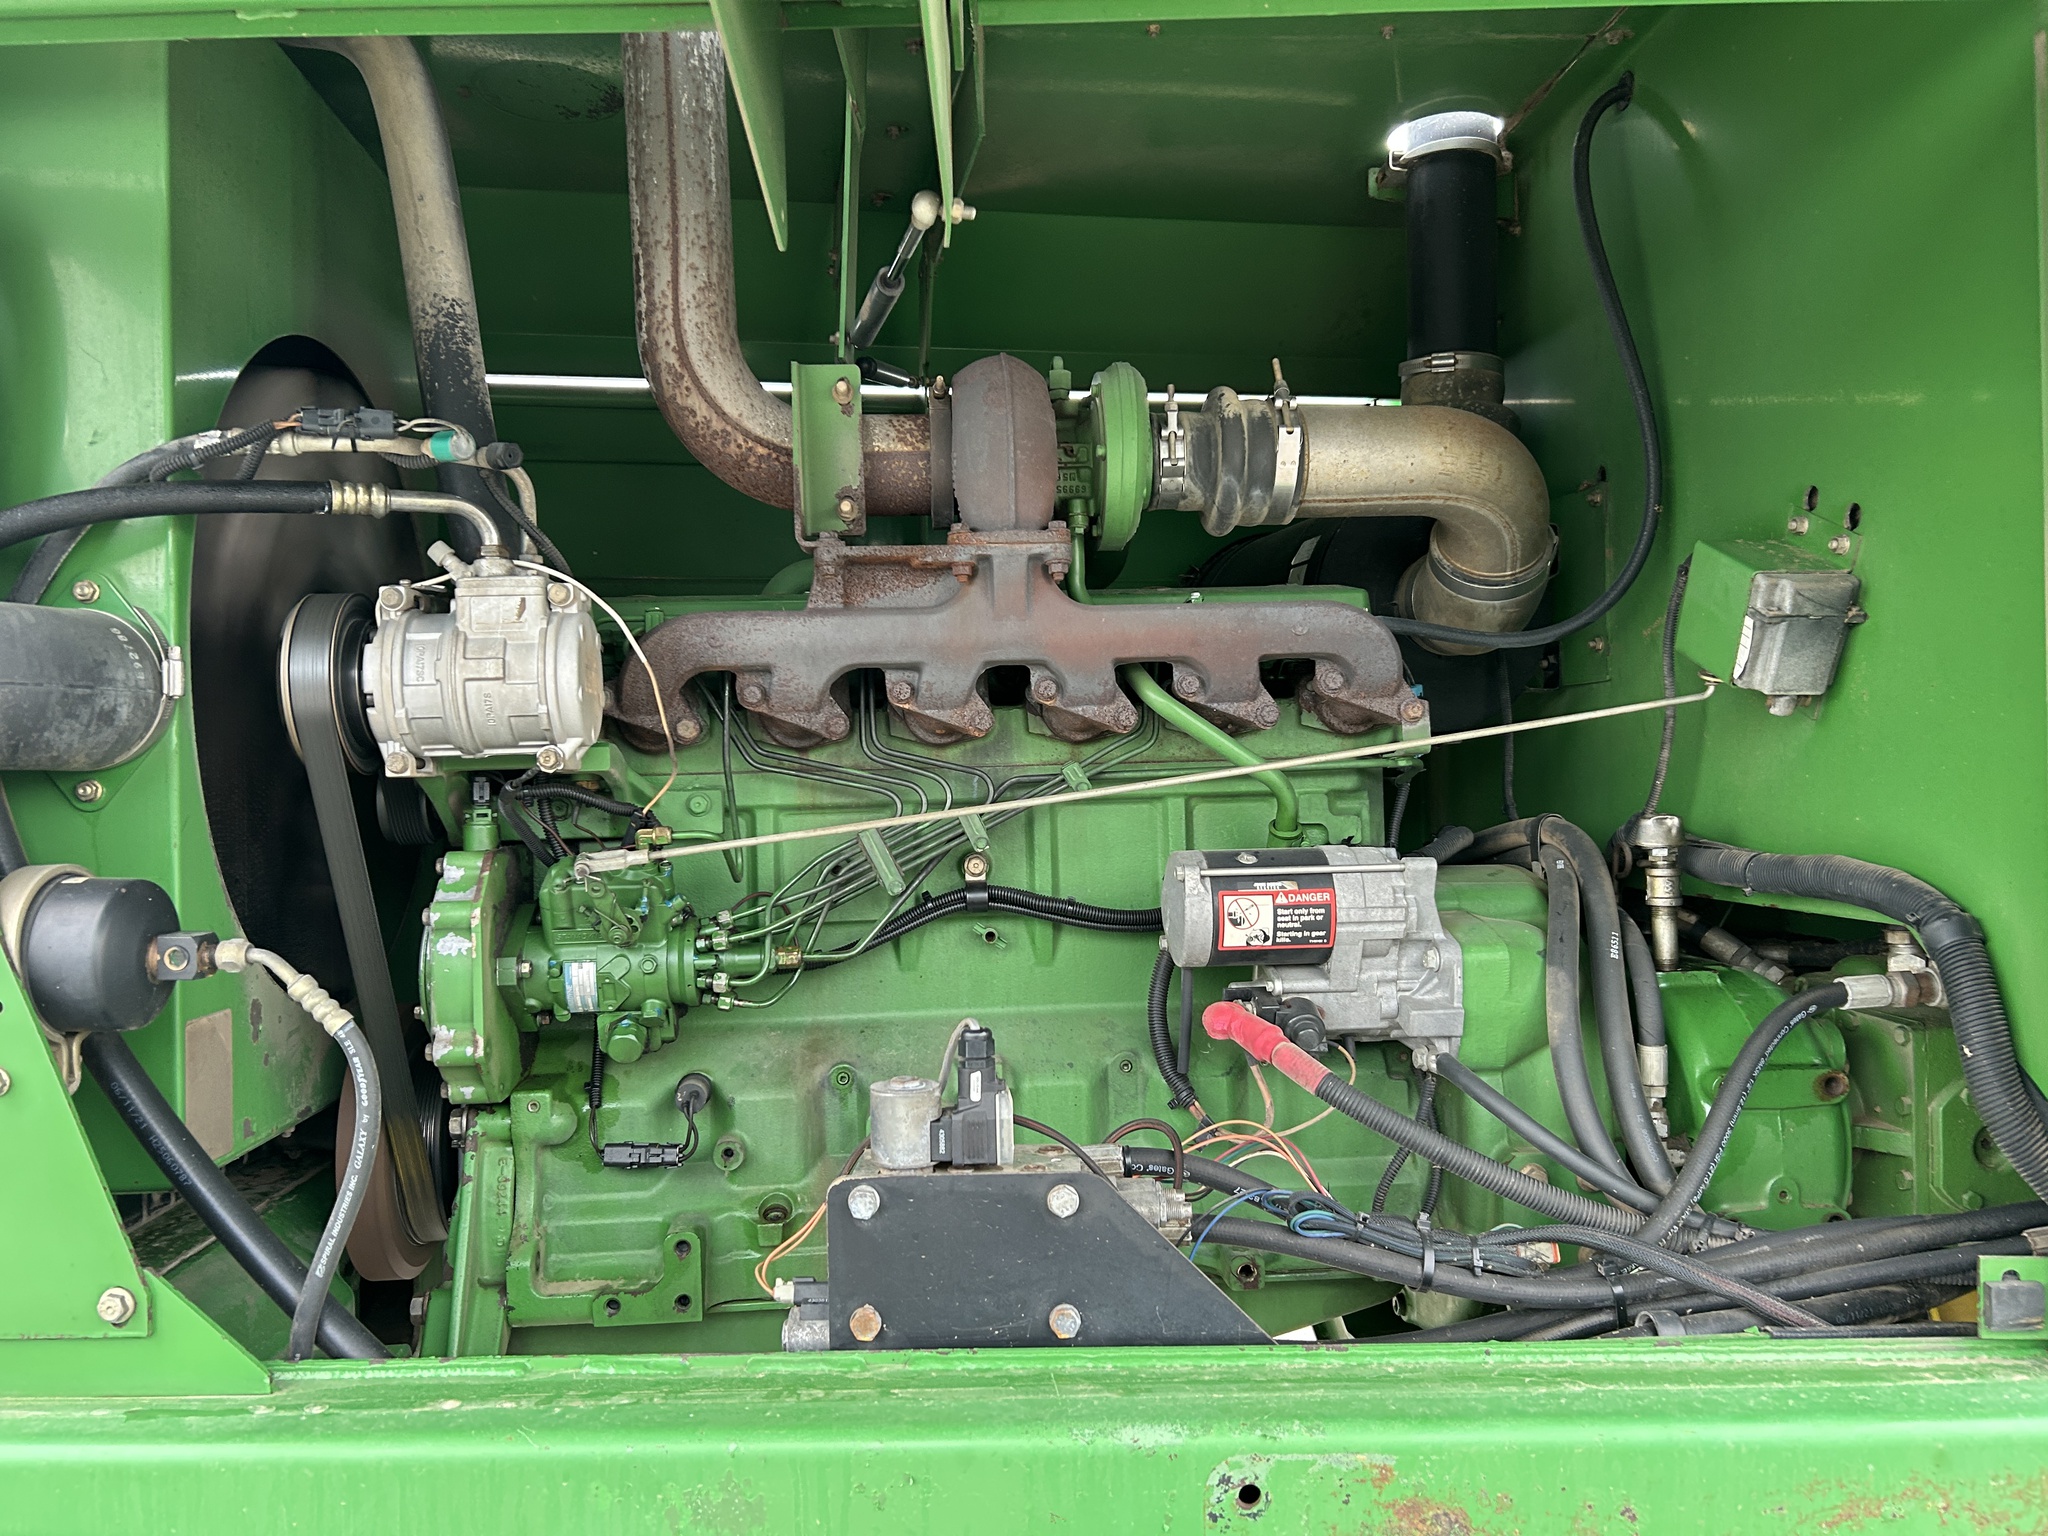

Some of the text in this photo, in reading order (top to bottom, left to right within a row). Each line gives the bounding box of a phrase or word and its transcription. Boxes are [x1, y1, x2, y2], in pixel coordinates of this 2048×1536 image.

[1287, 892, 1331, 903] DANGER
[1294, 908, 1309, 916] only
[1276, 930, 1303, 938] Starting
[1610, 931, 1619, 959] E86511
[352, 1056, 369, 1107] GOODYEAR
[361, 1114, 370, 1123] by
[353, 1128, 368, 1170] GALAXY
[348, 1174, 359, 1192] INC.
[331, 1190, 353, 1239] INDUSTRIES
[320, 1237, 336, 1265] SPIRAL
